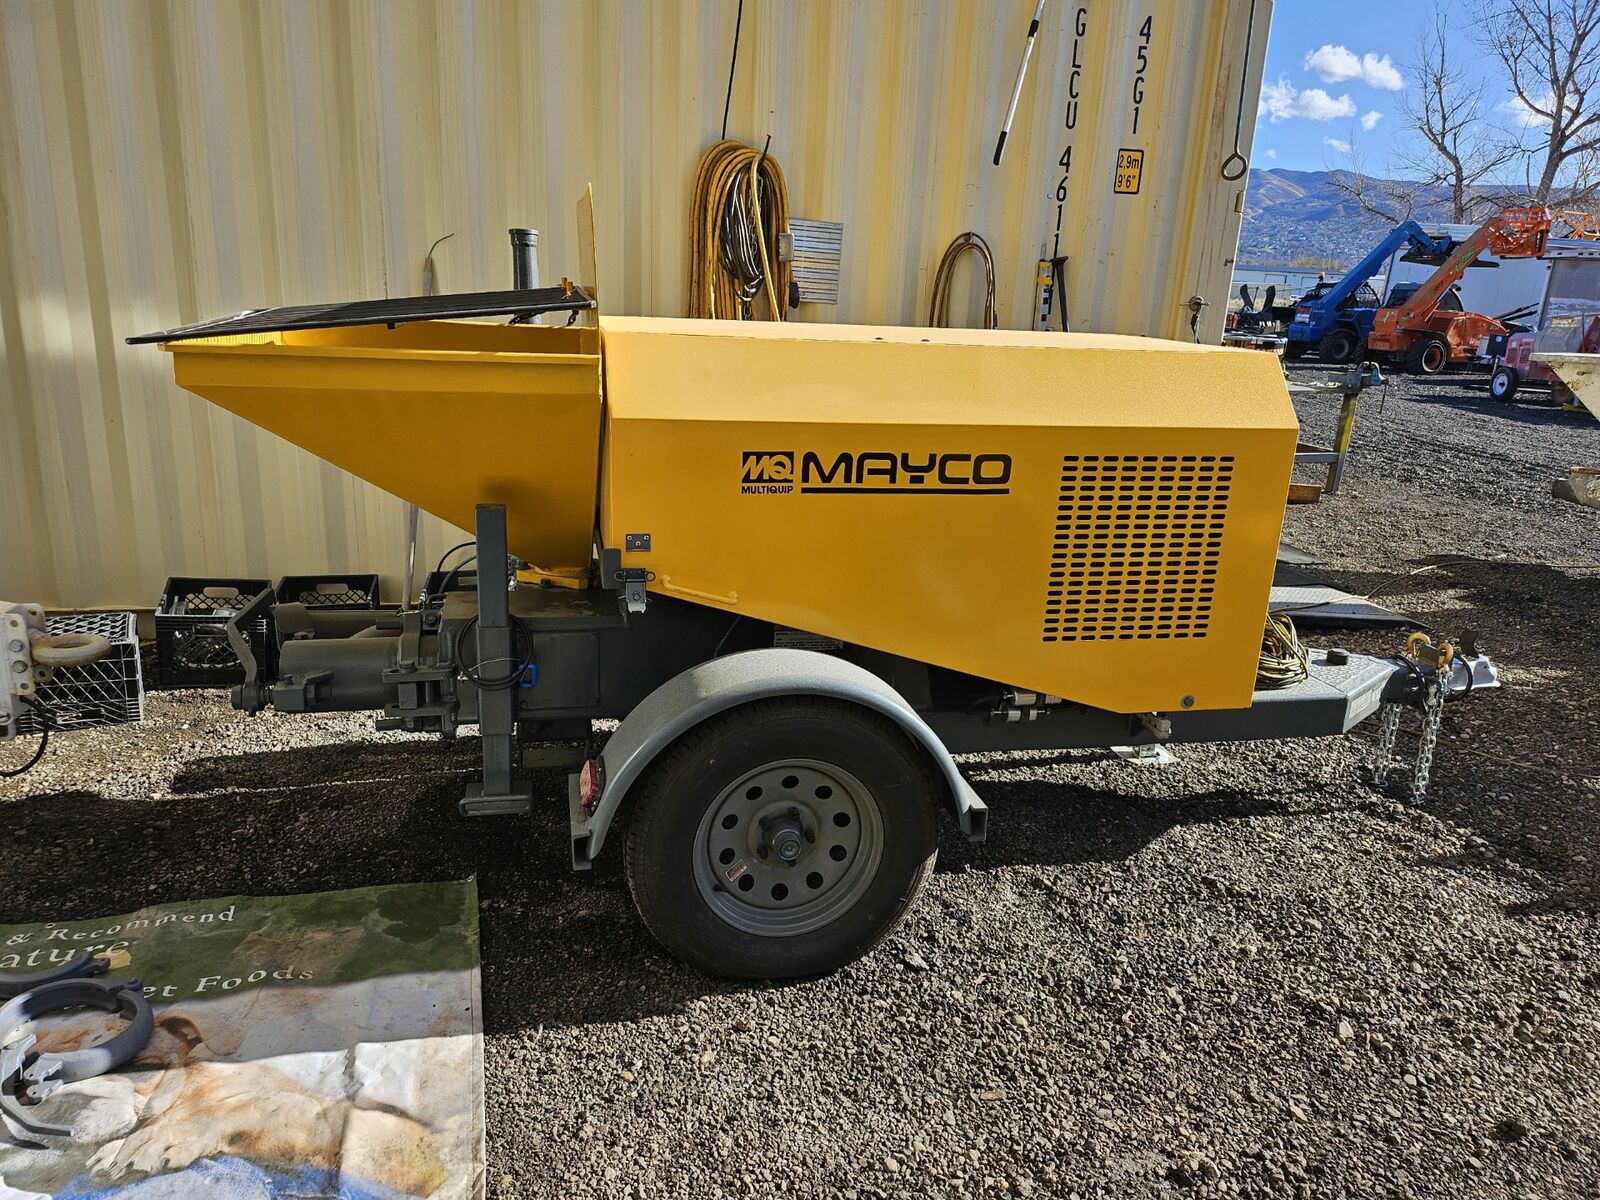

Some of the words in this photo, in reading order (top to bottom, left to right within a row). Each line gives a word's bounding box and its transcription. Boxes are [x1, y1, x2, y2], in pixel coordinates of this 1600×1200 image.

[1066, 8, 1087, 129] GLCU
[1132, 15, 1152, 134] 45G1
[1119, 154, 1140, 171] 2,9m
[742, 454, 794, 480] MQ
[801, 451, 1012, 485] MAYCO
[741, 485, 794, 495] MULTIQUIP
[6, 932, 34, 946] &
[45, 905, 236, 940] Recommend
[194, 965, 314, 992] Foods
